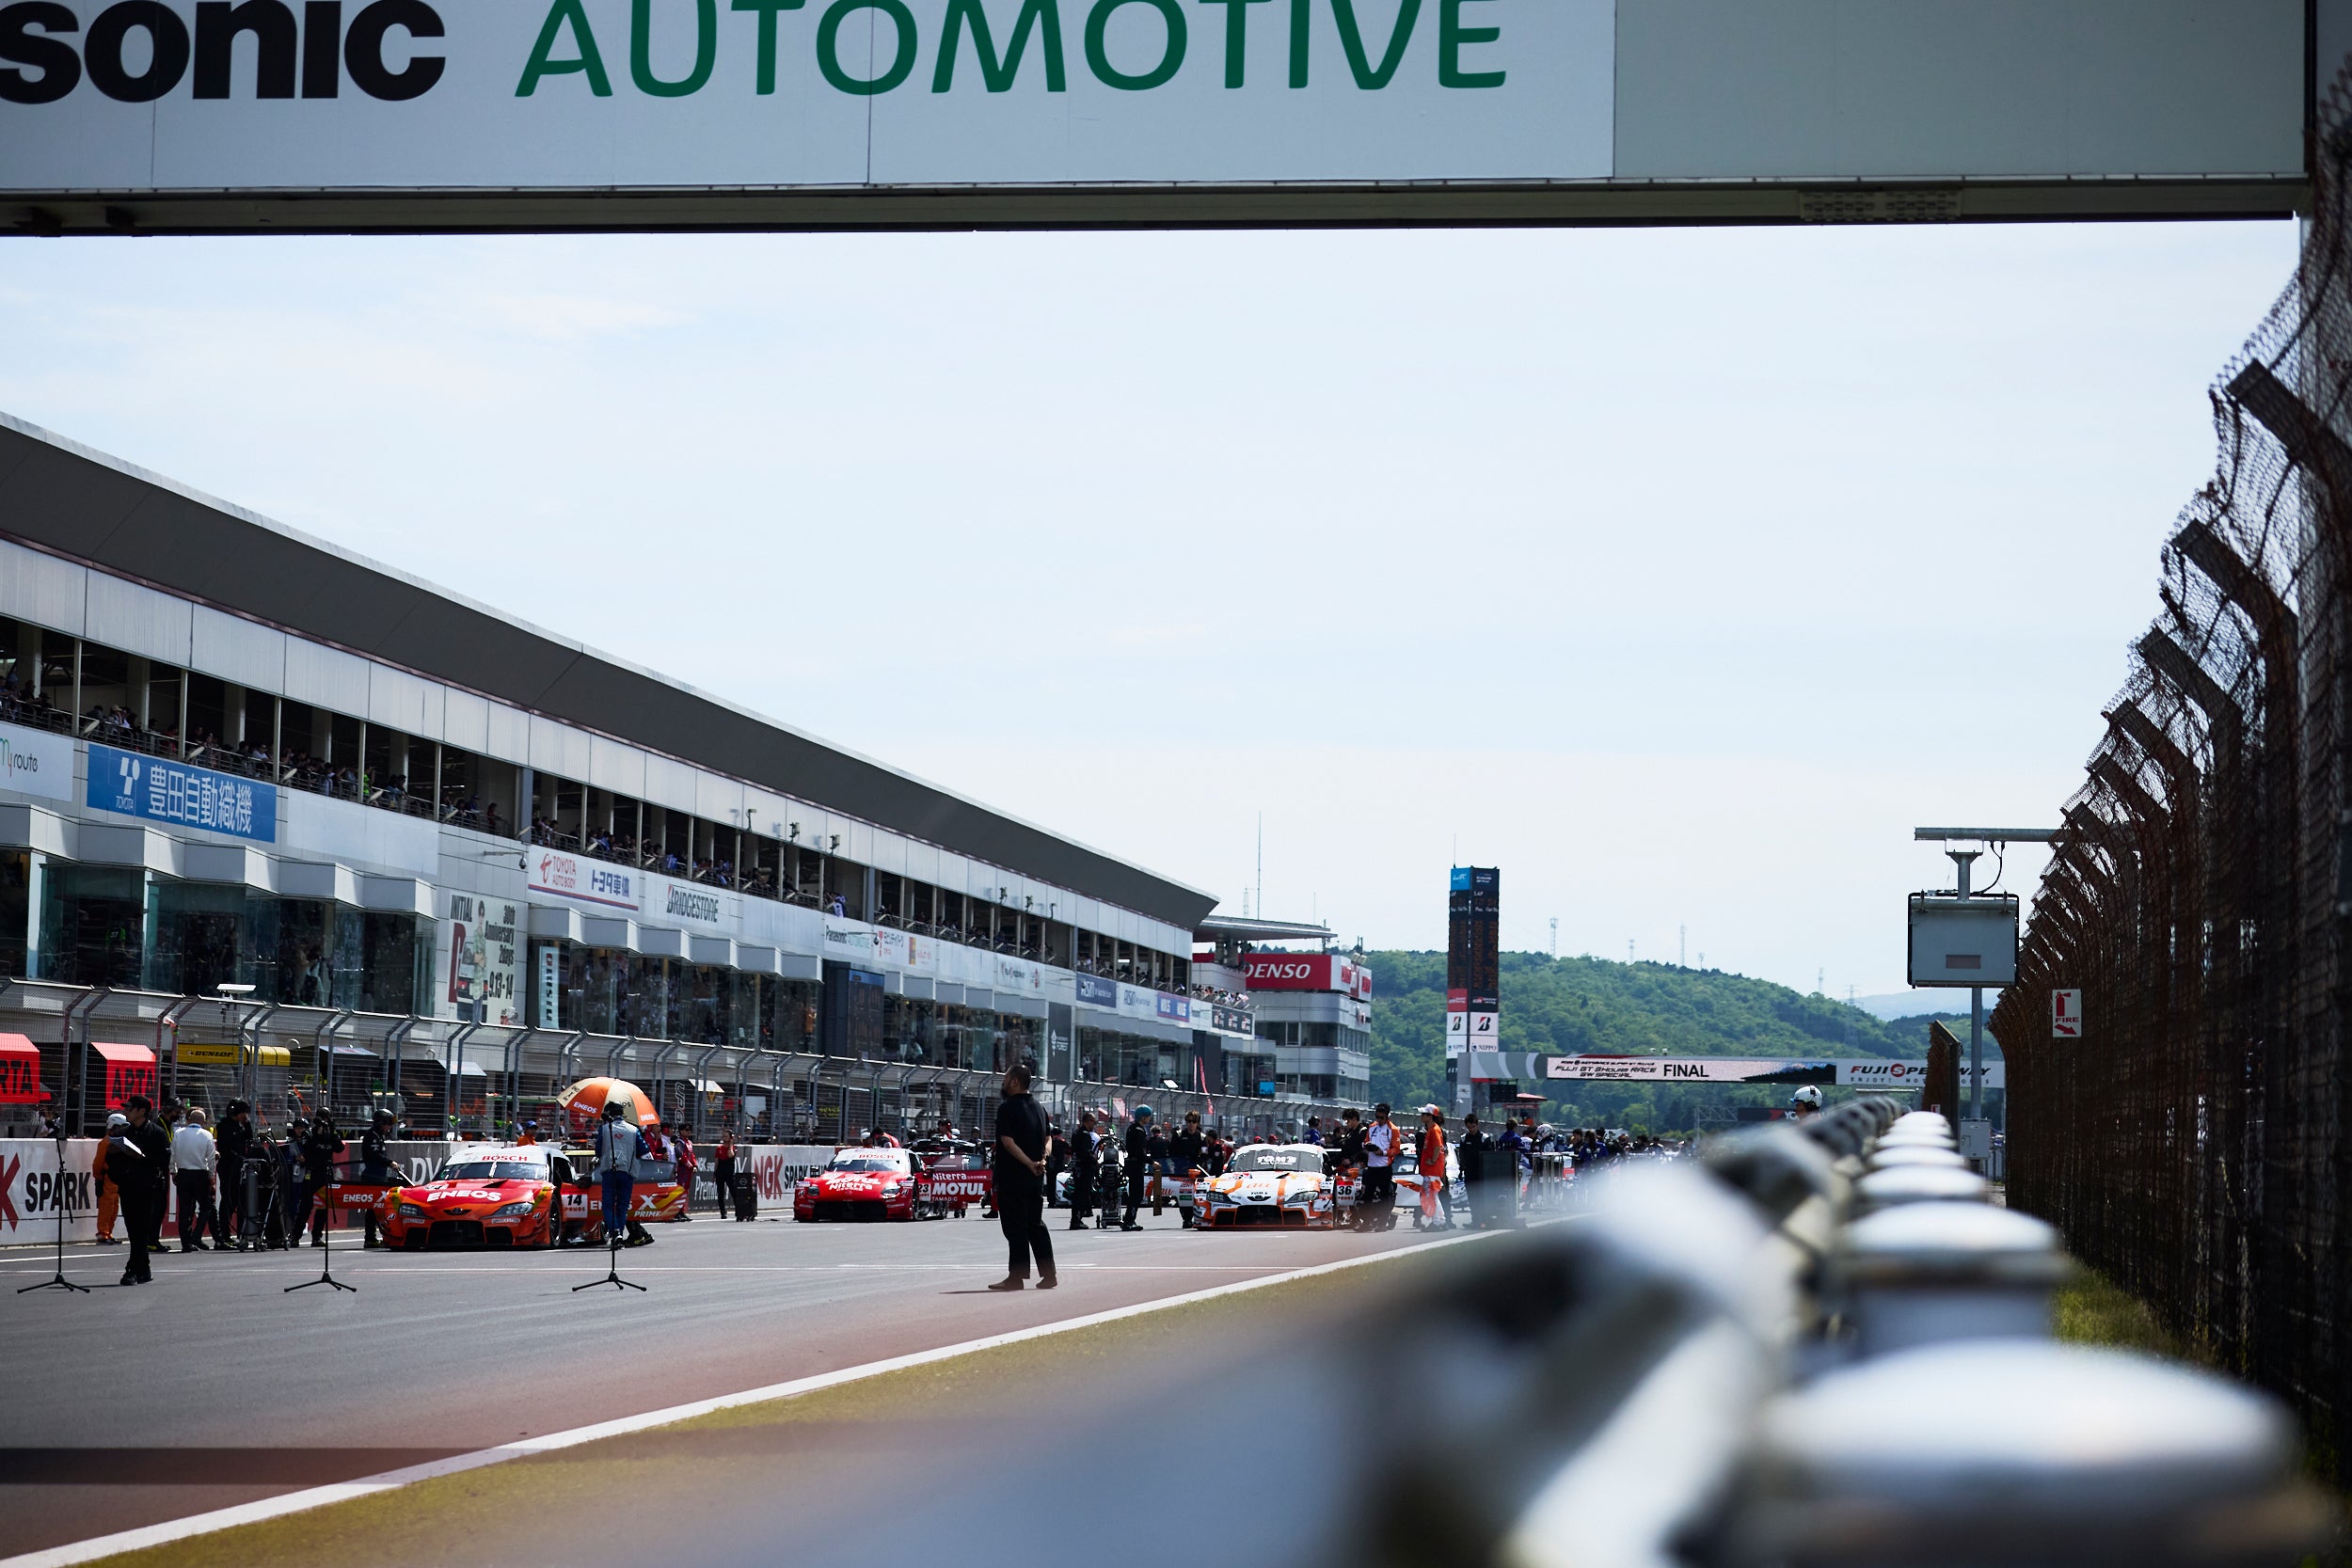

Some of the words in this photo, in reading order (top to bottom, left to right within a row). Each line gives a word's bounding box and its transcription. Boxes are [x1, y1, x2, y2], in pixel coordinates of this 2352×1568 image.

[515, 0, 1507, 98] AUTOMOTIVE
[13, 753, 38, 772] route
[116, 796, 134, 810] TOYOTA
[148, 765, 252, 834] 豊田自動織機
[552, 856, 577, 875] TOYOTA
[551, 875, 564, 887] AUTO
[591, 870, 630, 898] トヨタ車体
[451, 895, 473, 922] INITIAL
[666, 883, 719, 923] BRIDGESTONE
[499, 944, 515, 967] 2days
[1663, 1064, 1709, 1078] FINAL
[111, 1068, 156, 1101] ARTA
[573, 1101, 597, 1114] ENEOS
[410, 1157, 443, 1185] DV
[755, 1154, 783, 1201] NGK
[932, 1173, 967, 1181] Niterra
[826, 1177, 881, 1185] MOTUL
[829, 1182, 873, 1191] Niterra
[931, 1182, 986, 1196] MOTUL
[24, 1172, 91, 1212] SPARK
[426, 1190, 502, 1203] ENEOS
[1338, 1185, 1352, 1195] 36
[342, 1194, 373, 1203] ENEOS
[567, 1195, 582, 1206] 14
[639, 1195, 657, 1211] X
